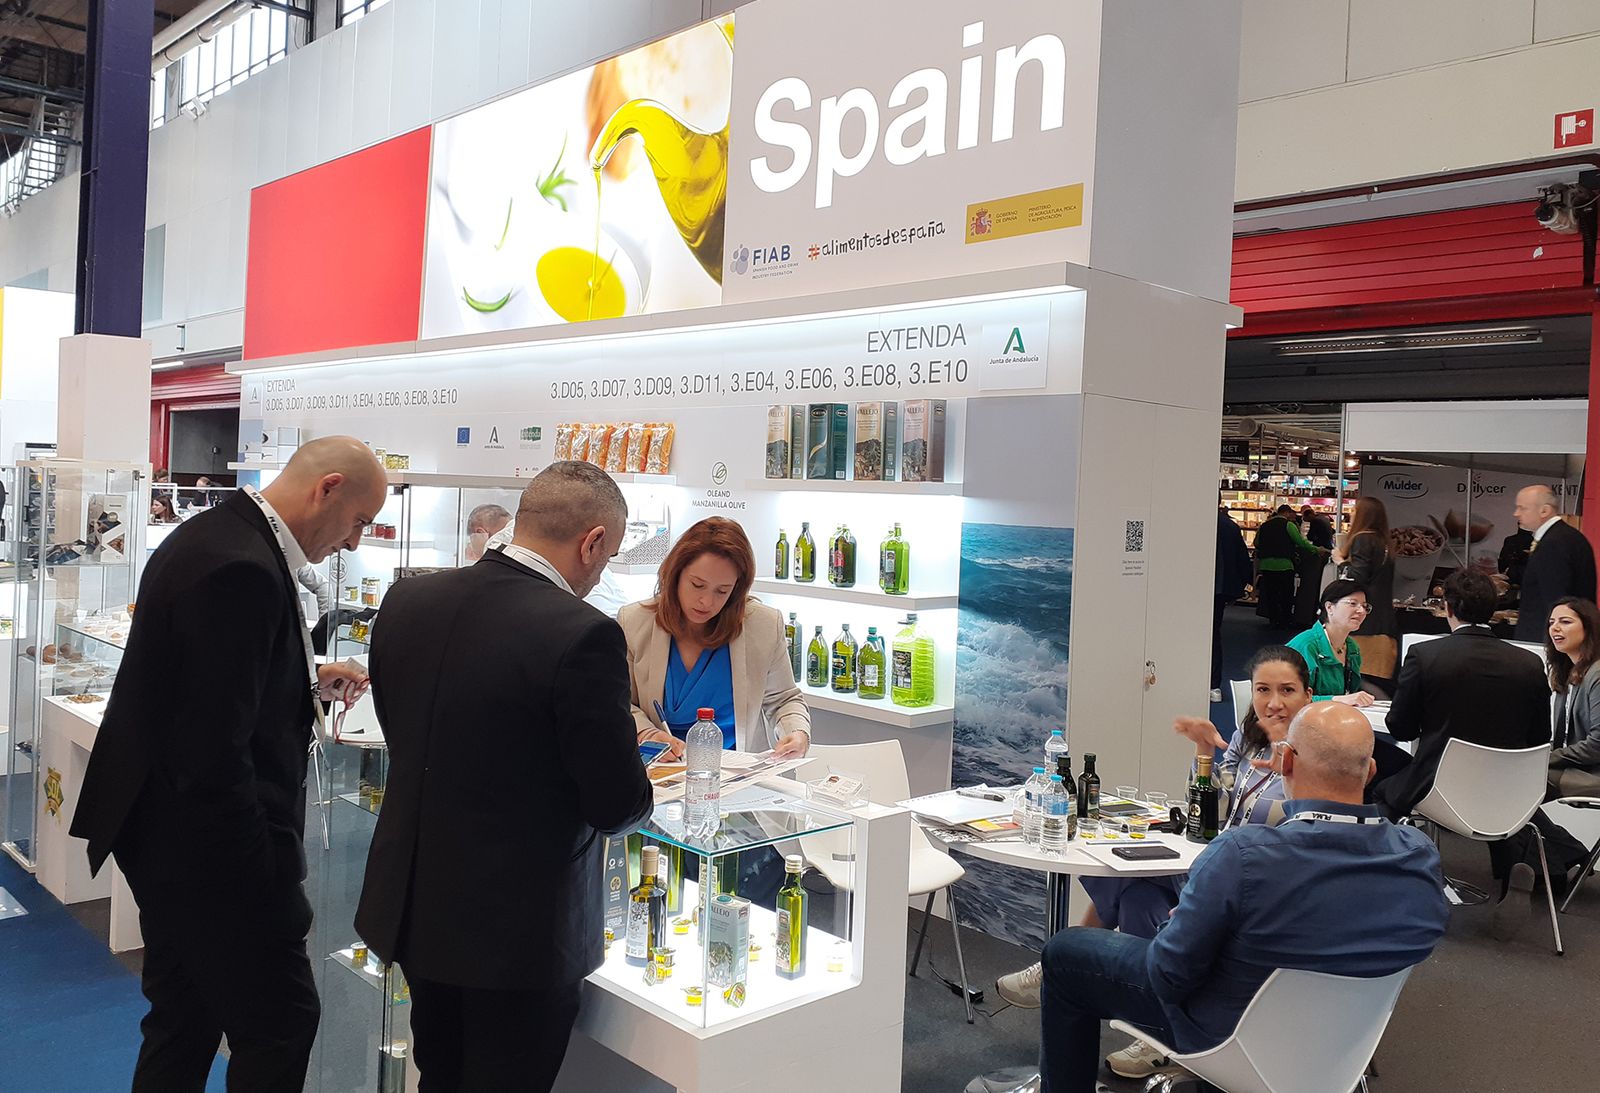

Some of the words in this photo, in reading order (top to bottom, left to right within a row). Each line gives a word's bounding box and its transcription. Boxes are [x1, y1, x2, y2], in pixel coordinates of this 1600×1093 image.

[750, 20, 1066, 210] Spain
[808, 221, 946, 261] #alimentosdespaña
[752, 245, 791, 265] FIAB
[867, 323, 967, 353] EXTENDA
[267, 378, 296, 392] EXTENDA
[550, 381, 587, 400] 3.D05,
[590, 379, 629, 399] 3.D07,
[633, 376, 675, 397] 3.D09,
[680, 374, 725, 395] 3.D11,
[730, 371, 779, 394] 3.E04,
[784, 367, 837, 391] 3.E06,
[843, 363, 901, 389] 3.E08,
[909, 359, 968, 384] 3.E10
[286, 397, 306, 411] 3.D07,
[307, 396, 328, 410] 3.D09,
[329, 394, 351, 410] 3.D11,
[352, 393, 375, 408] 3.E04,
[377, 391, 401, 407] 3.E06,
[404, 390, 430, 406] 3.E08,
[432, 388, 458, 405] 3.E10
[1384, 480, 1423, 491] Mulder
[1457, 480, 1506, 499] Dilycer
[692, 500, 728, 508] MANZANILLA
[728, 501, 746, 509] OLIVE
